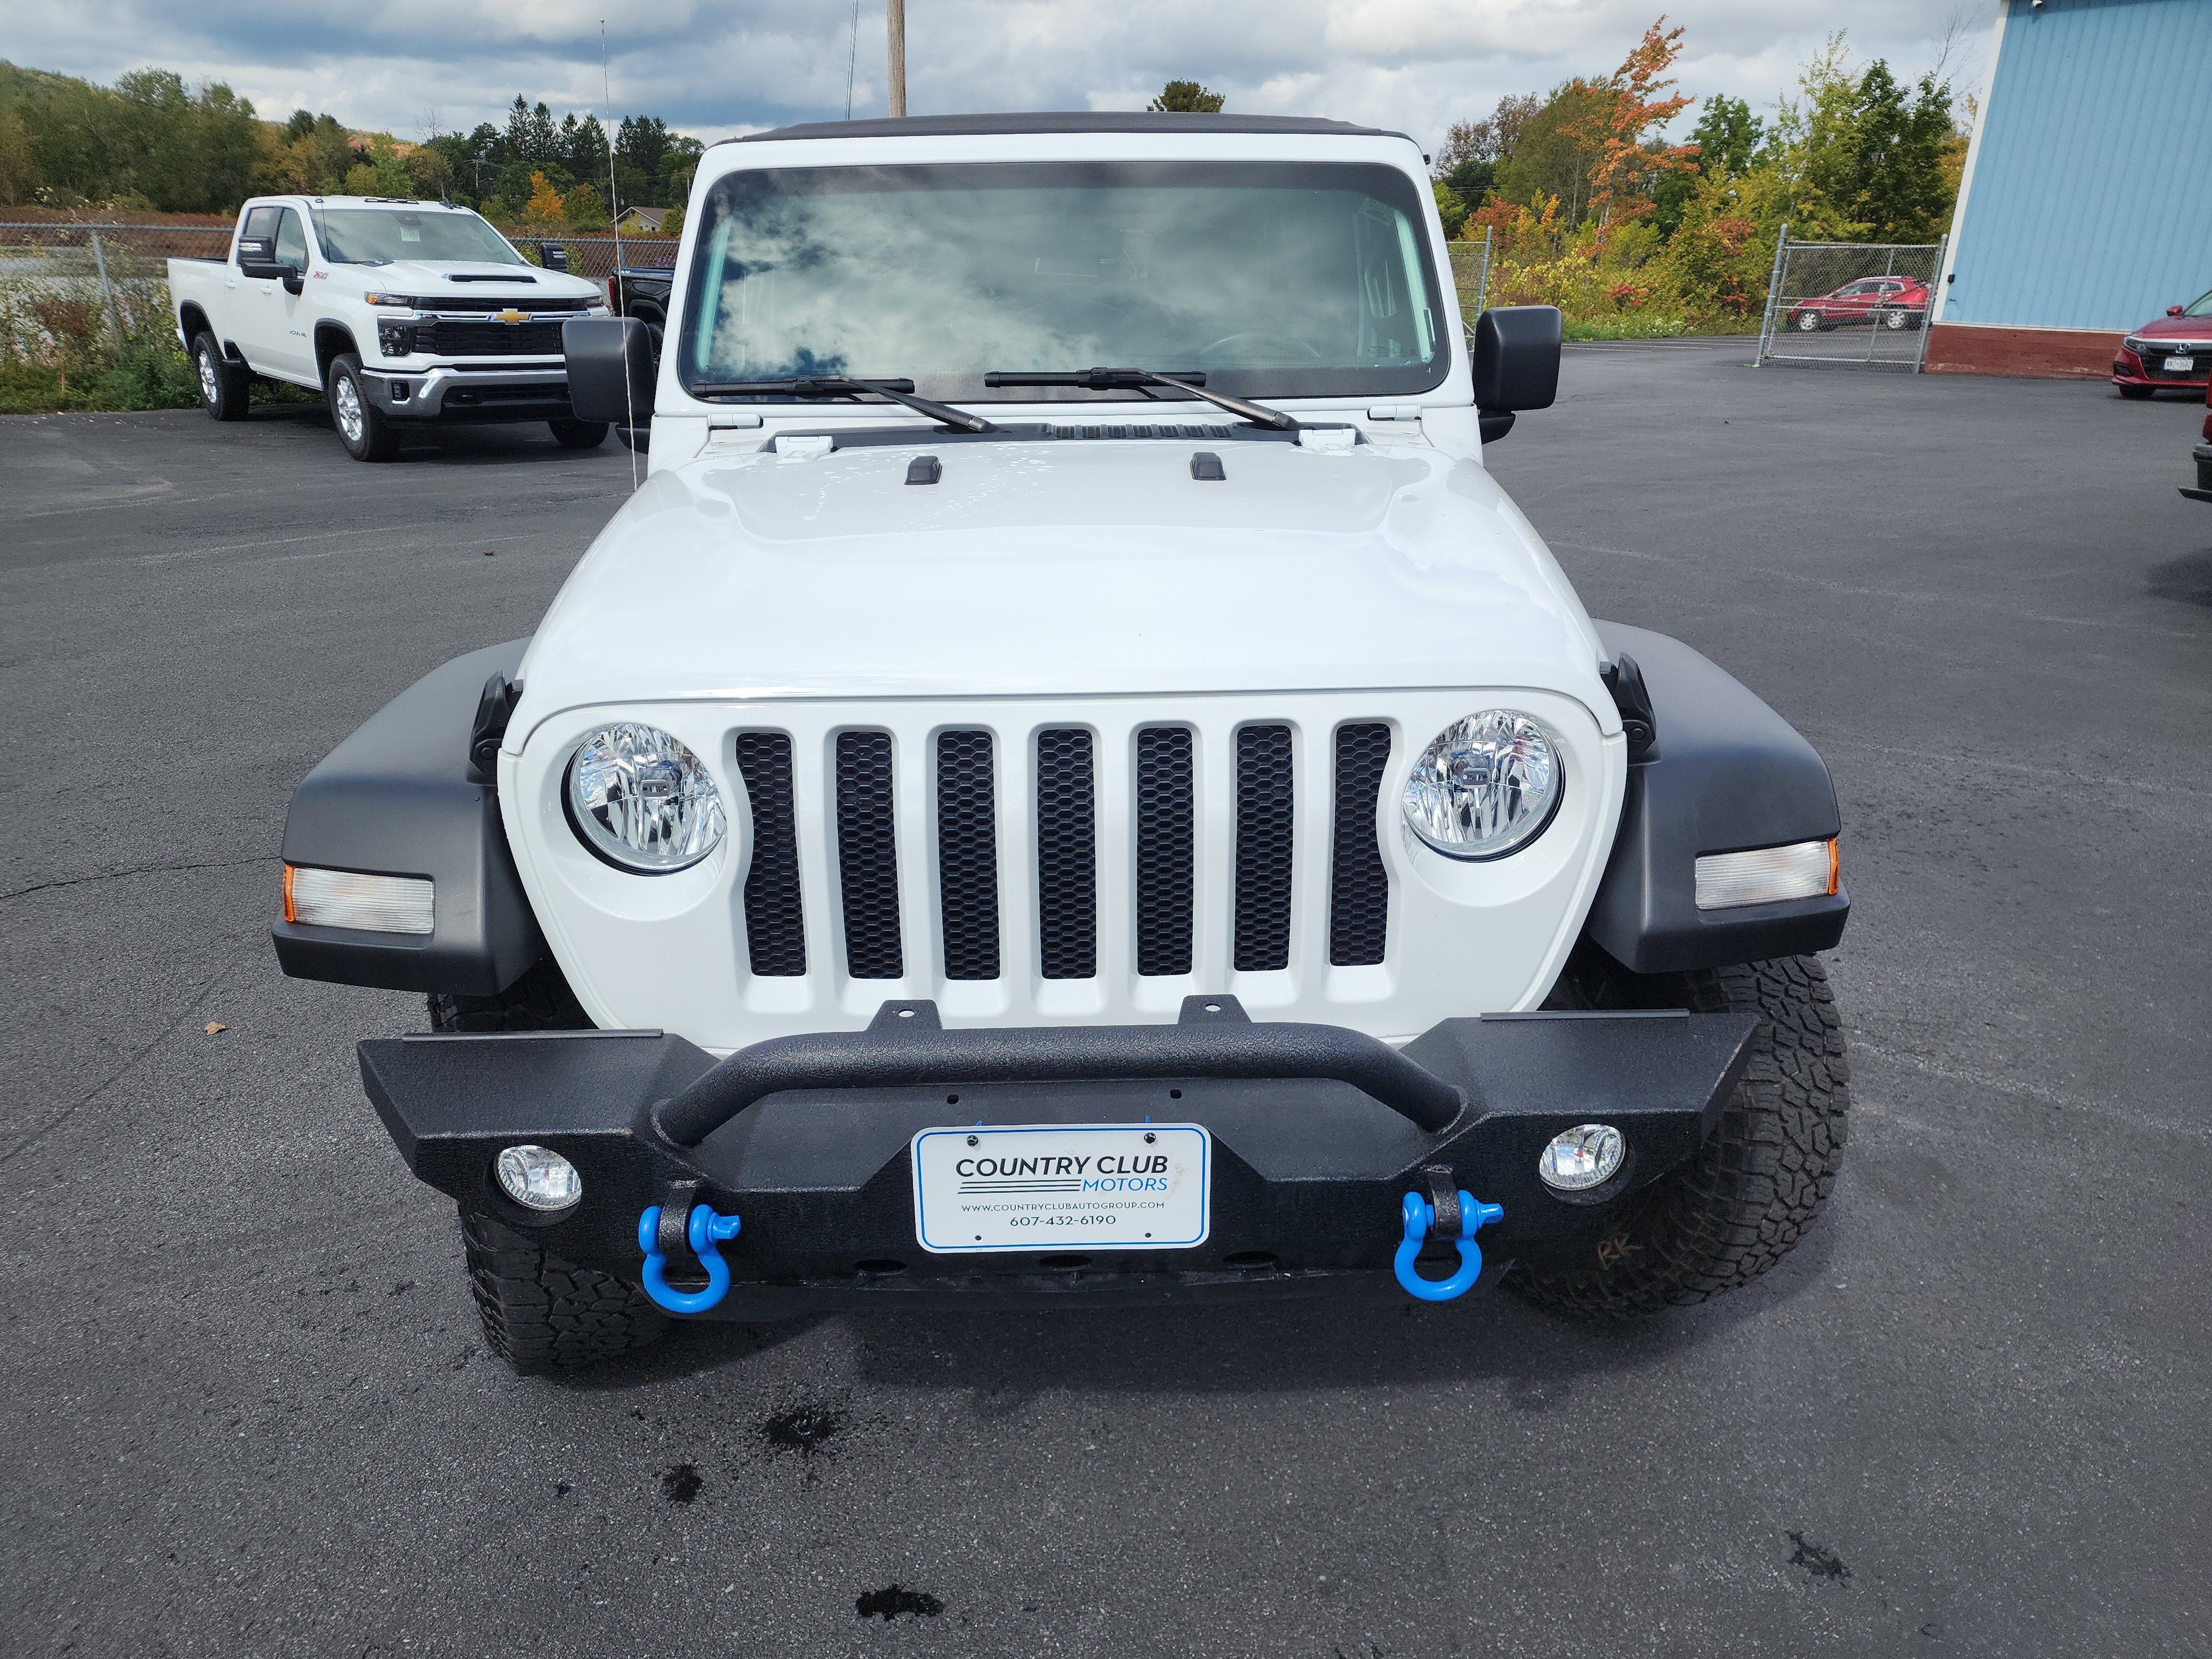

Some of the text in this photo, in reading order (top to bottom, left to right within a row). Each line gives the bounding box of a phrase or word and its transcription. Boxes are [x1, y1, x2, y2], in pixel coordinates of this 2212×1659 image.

[956, 1155, 1168, 1177] COUNTRY CLUB
[1082, 1177, 1168, 1192] MOTORS
[961, 1202, 1165, 1212] WWW.COUNTRYCLUBAUTOGROUP.COM
[1010, 1215, 1116, 1227] 607-432-6190
